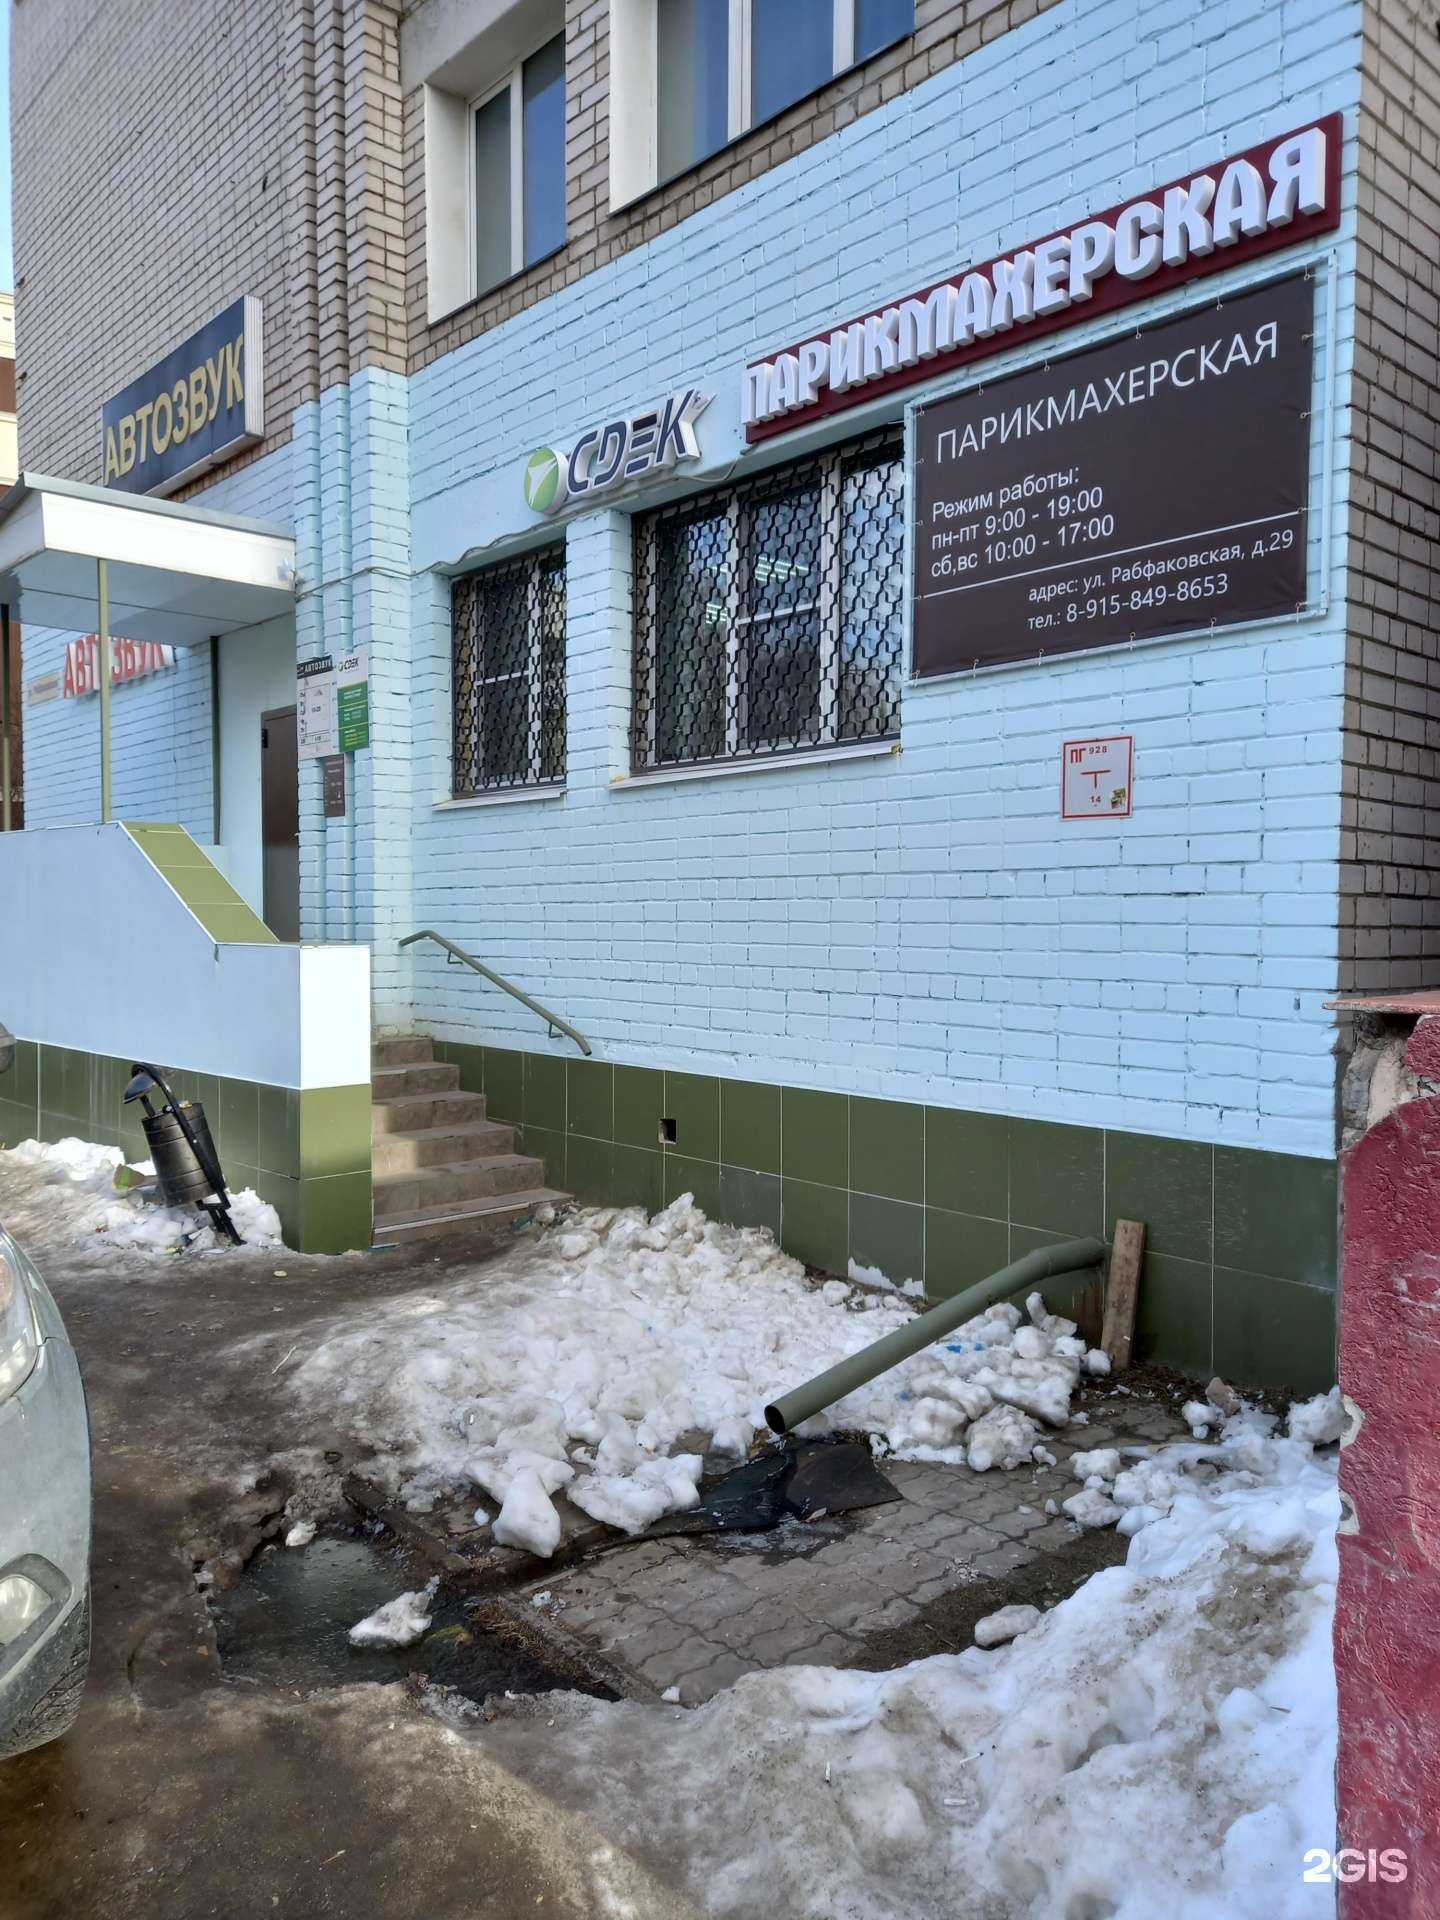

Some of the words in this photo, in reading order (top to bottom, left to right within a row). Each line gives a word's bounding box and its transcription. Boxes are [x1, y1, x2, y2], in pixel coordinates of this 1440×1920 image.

[741, 126, 1326, 426] ПАРИКМАХЕРСКАЯ
[103, 334, 243, 485] АВТОЗВУК
[936, 321, 1278, 464] ПАРИКМАХЕРСКАЯ
[931, 526, 978, 551] пн-пт
[985, 509, 1026, 537] 9:00
[1047, 486, 1103, 520] 19:00
[932, 491, 993, 522] Режим
[999, 466, 1080, 508] работы:
[931, 547, 978, 578] сб,вс
[985, 538, 1036, 565] 10:00
[1058, 514, 1115, 548] 17:00
[1029, 579, 1079, 603] адрес:
[1083, 573, 1106, 595] ул.
[1112, 544, 1245, 584] Рабфаковская,
[1251, 529, 1294, 559] д.29
[1028, 611, 1062, 630] тел.:
[1066, 573, 1229, 623] 8-915-849-8653
[1070, 748, 1086, 763] ПГ
